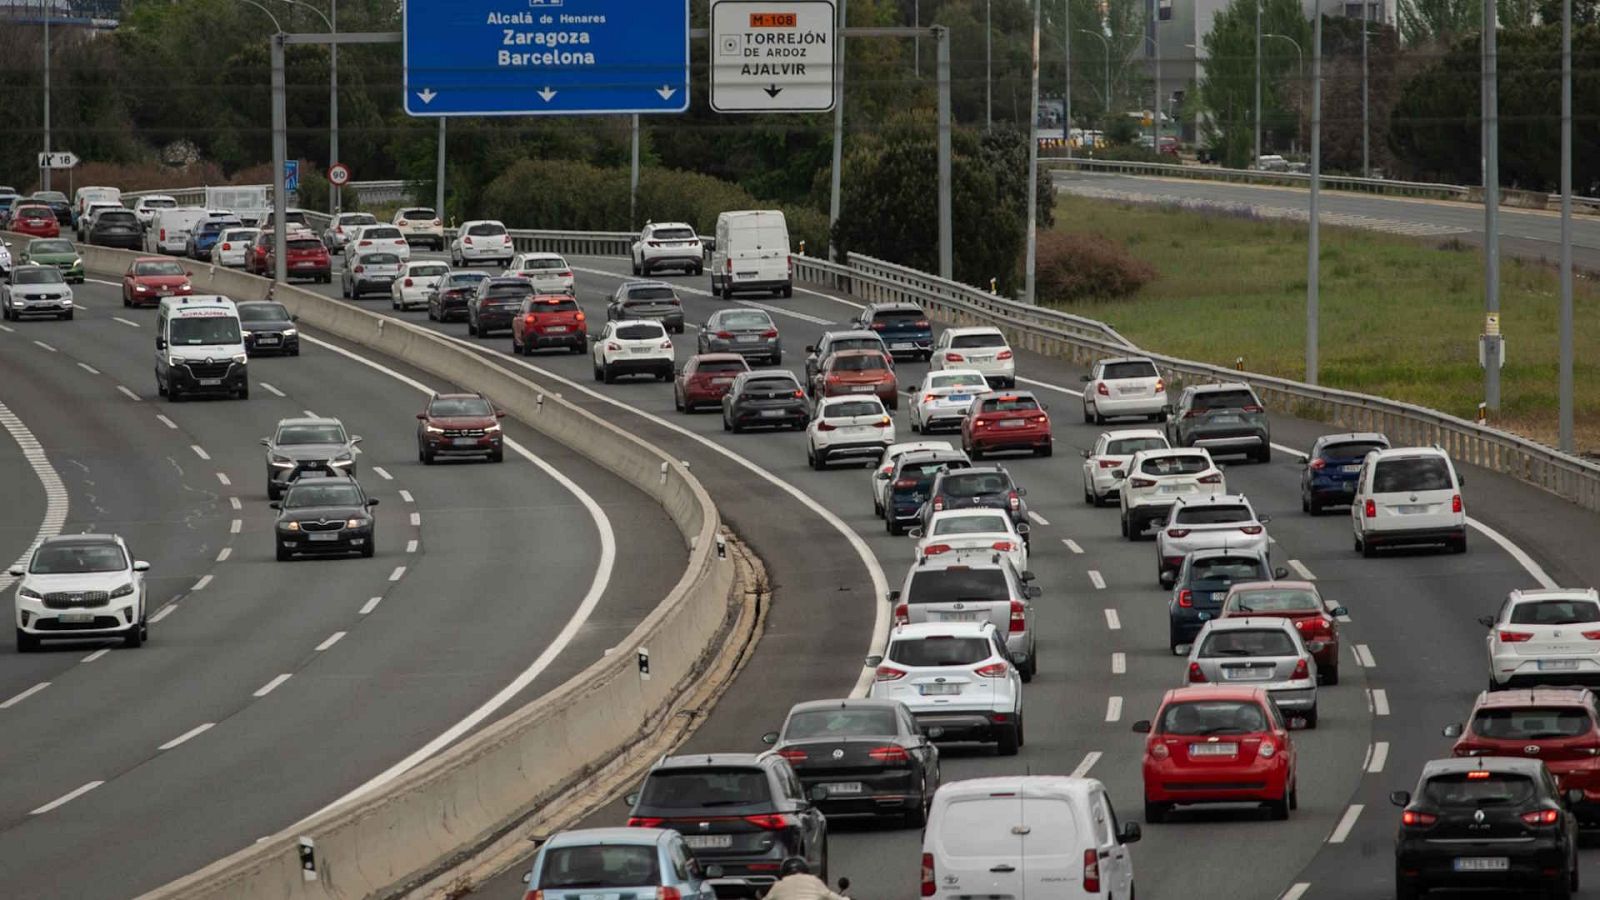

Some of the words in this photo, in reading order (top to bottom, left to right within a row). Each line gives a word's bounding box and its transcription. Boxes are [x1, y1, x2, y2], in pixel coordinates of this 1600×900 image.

[487, 11, 533, 24] Alcalá
[540, 14, 553, 24] de
[560, 14, 606, 24] Henares
[753, 15, 793, 25] M-108
[503, 29, 590, 47] Zaragoza
[744, 30, 826, 45] TORREJÓN
[498, 49, 595, 65] Barcelona
[744, 48, 759, 57] DE
[766, 48, 807, 57] ARDOZ
[741, 63, 806, 75] AJALVIR
[333, 171, 346, 180] 90
